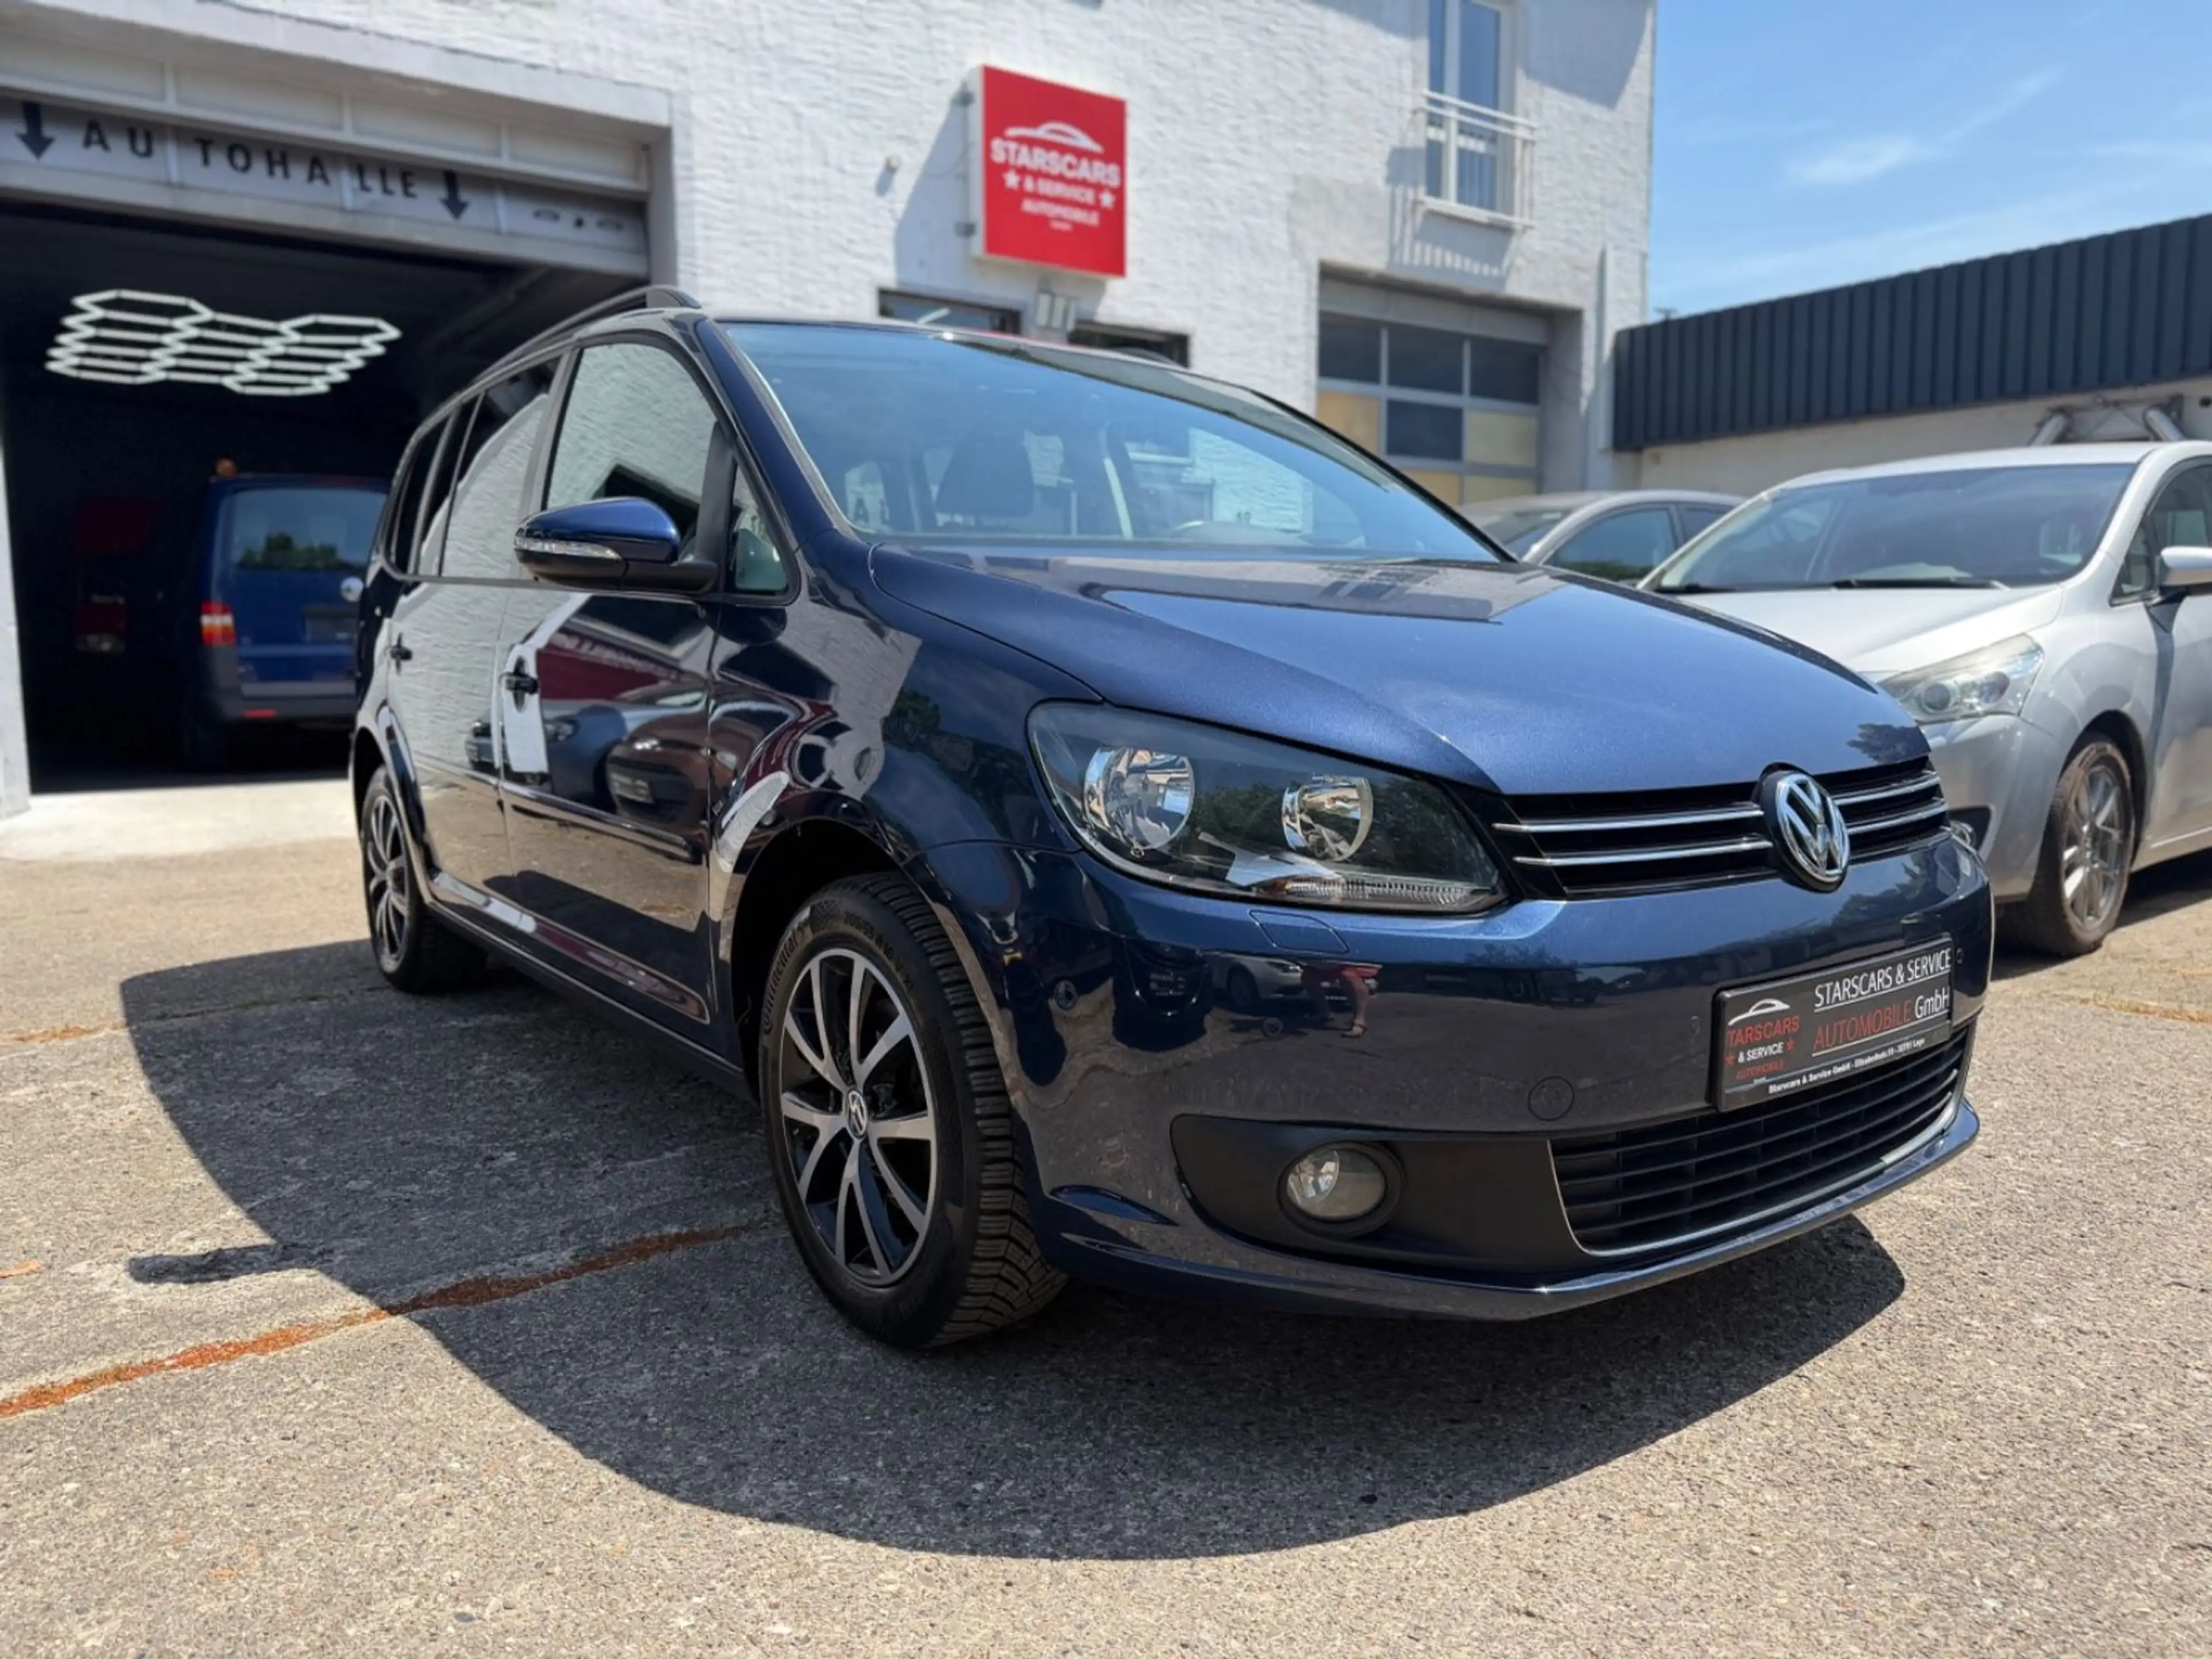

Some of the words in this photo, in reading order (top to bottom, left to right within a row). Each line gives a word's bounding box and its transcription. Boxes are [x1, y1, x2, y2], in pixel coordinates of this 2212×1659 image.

[990, 137, 1121, 188] STARSCARS
[1815, 966, 1893, 1007] STARSCARS
[1895, 963, 1904, 985] &
[1907, 948, 1952, 982] SERVICE
[1726, 1016, 1800, 1047] TARSCARS
[1814, 999, 1912, 1050] AUTOMOBILE
[1914, 986, 1950, 1019] GmbH
[1746, 1041, 1785, 1062] SERVICE
